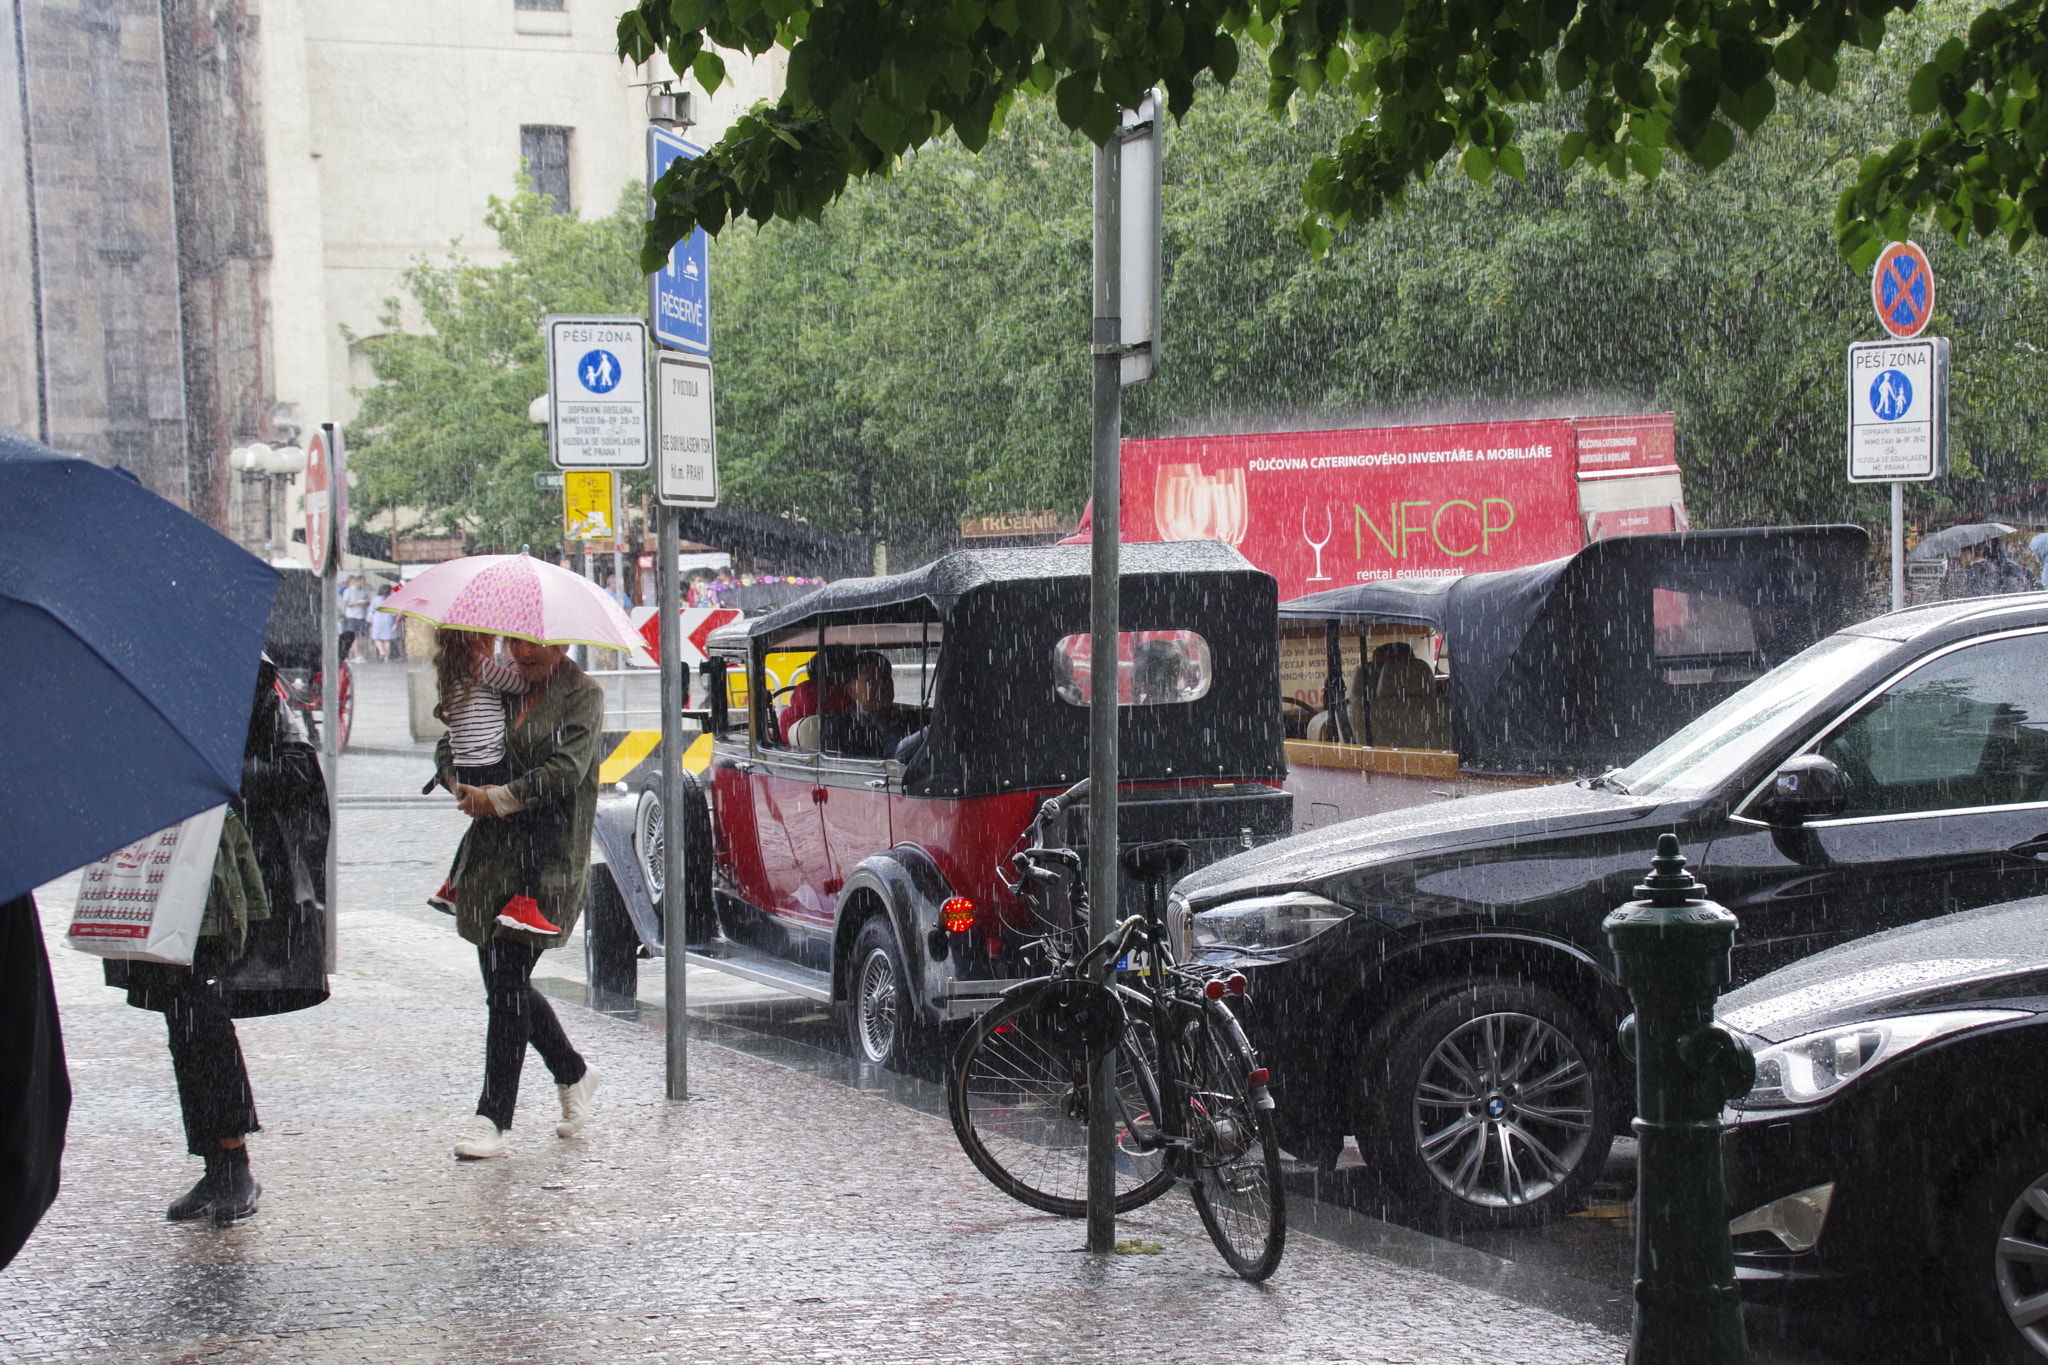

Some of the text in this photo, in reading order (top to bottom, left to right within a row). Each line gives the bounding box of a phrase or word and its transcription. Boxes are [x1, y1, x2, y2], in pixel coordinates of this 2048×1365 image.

[660, 290, 704, 327] RÉSERVÉ
[562, 329, 633, 342] PĚŠÍ ZÓNA
[1856, 349, 1926, 369] PĚŠÍ ZÓNA
[677, 379, 699, 398] VOZIDLA
[568, 404, 633, 414] DOPRAVNÍ OBSLUHA
[1861, 426, 1921, 436] DOPRAVNÍ OBSLUHA
[591, 437, 599, 446] SE
[663, 434, 669, 451] SE
[594, 448, 616, 456] PRAHA
[1249, 445, 1553, 472] PŮJČOVNA CATERINGOVÉHO INVENTÁŘE A MOBILIÁŘE
[1355, 499, 1515, 560] NFCP
[1357, 566, 1465, 580] rental equipment
